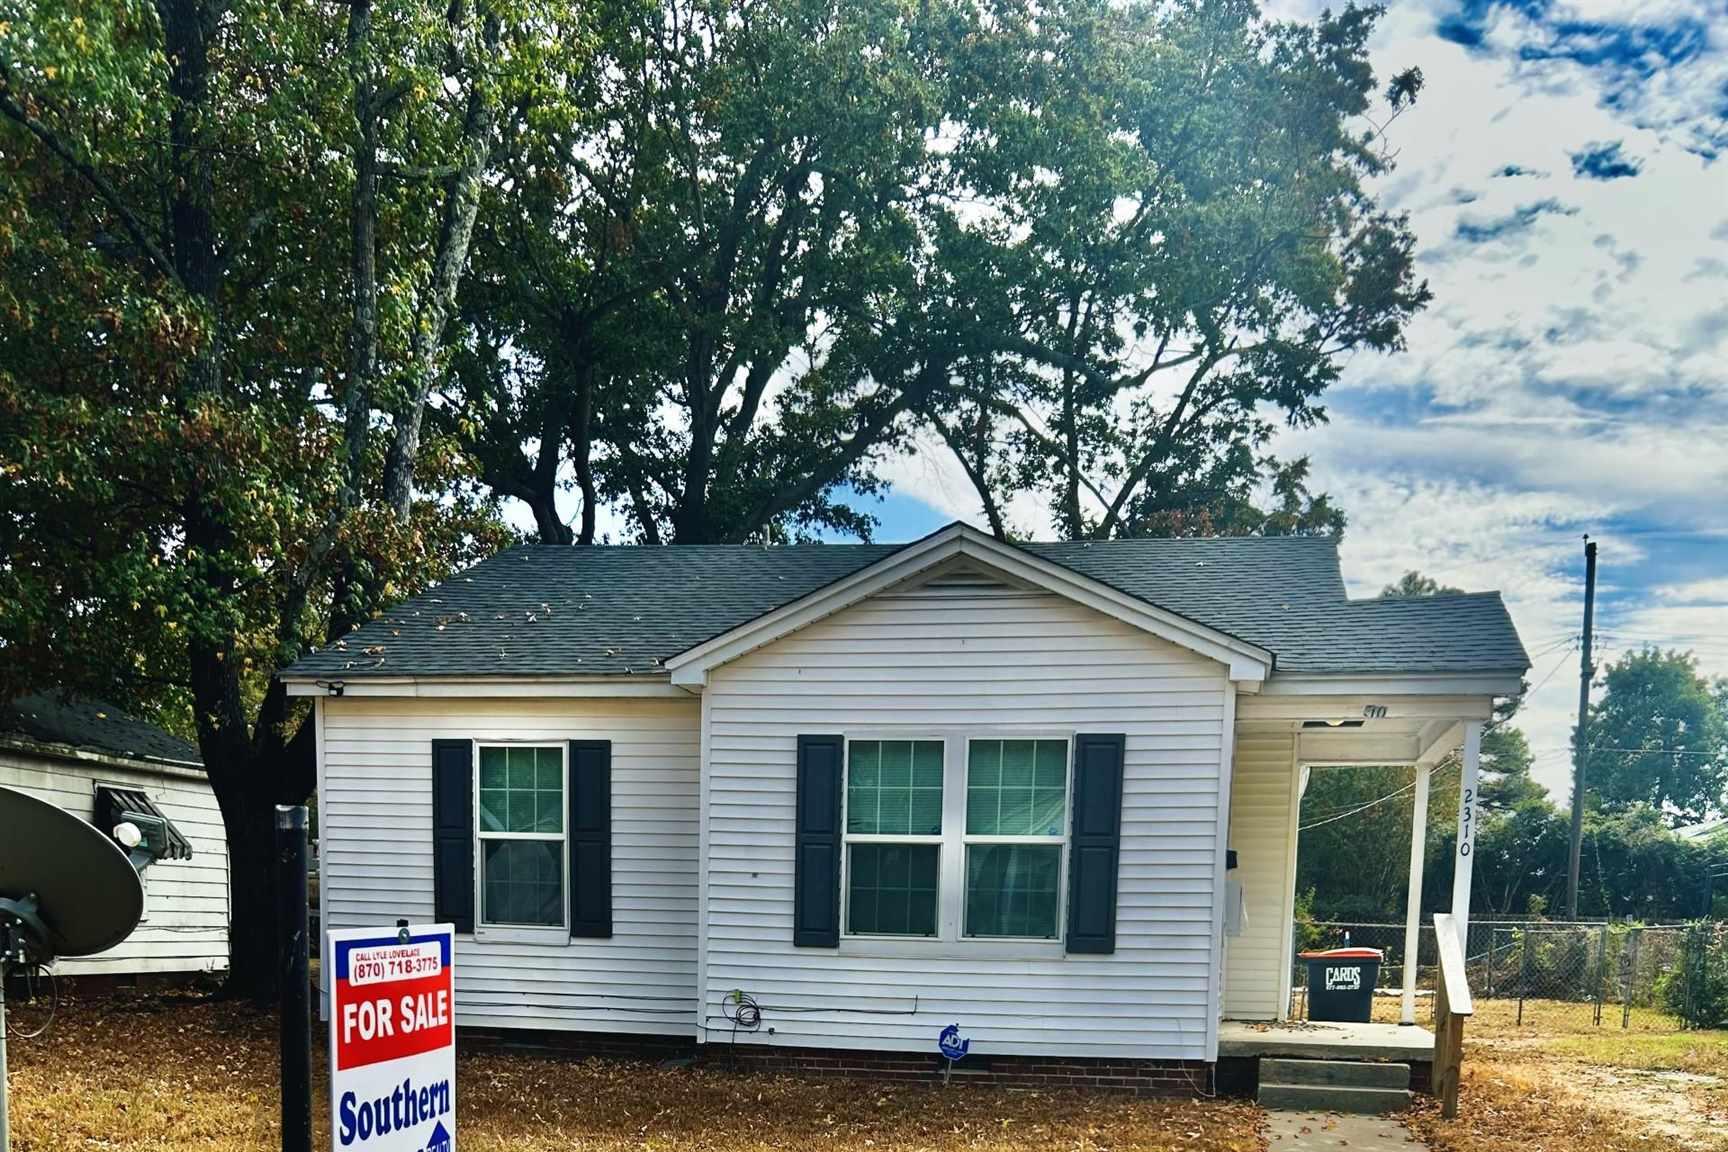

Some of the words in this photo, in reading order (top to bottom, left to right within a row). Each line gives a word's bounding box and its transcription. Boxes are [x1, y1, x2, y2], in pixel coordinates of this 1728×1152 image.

[1461, 789, 1473, 857] 2310
[354, 962, 385, 983] (870)
[388, 956, 438, 976] 718-3775
[355, 952, 371, 962] CALL
[373, 950, 387, 960] LYLE
[389, 948, 420, 959] LOVELACE
[1326, 966, 1361, 985] CARDS
[343, 998, 394, 1044] FOR
[400, 989, 448, 1034] SALE
[339, 1077, 451, 1147] Southern
